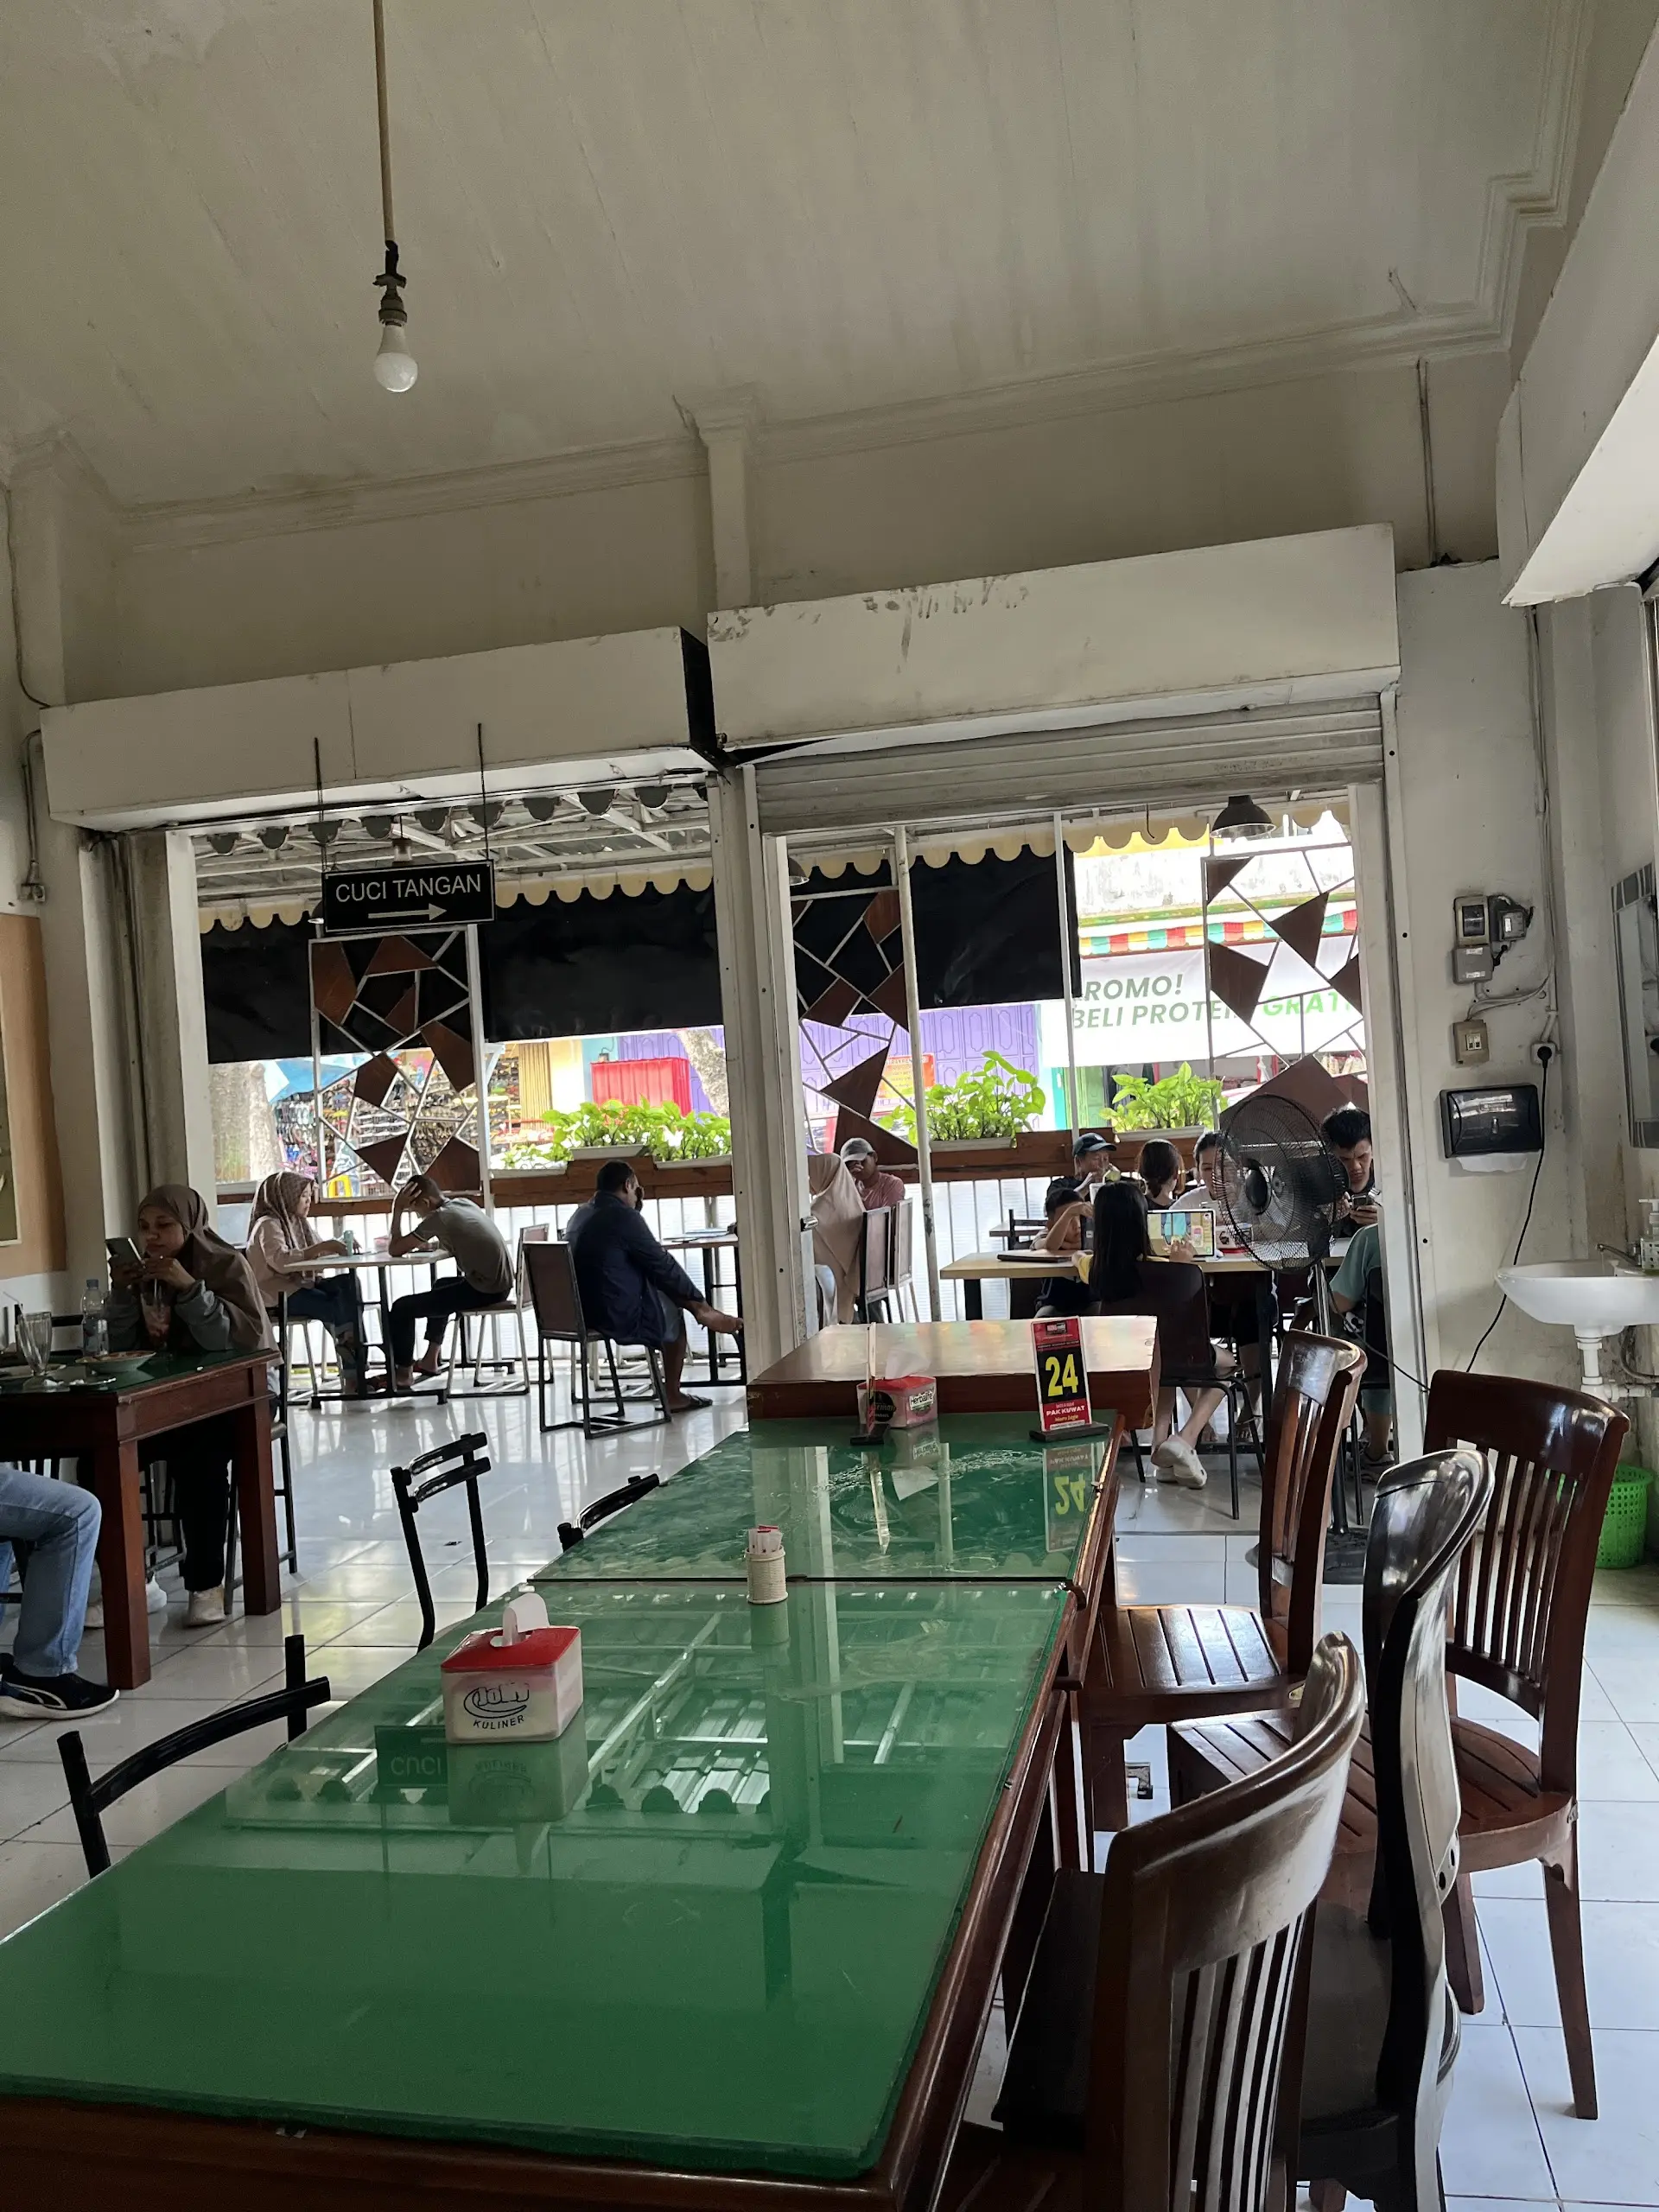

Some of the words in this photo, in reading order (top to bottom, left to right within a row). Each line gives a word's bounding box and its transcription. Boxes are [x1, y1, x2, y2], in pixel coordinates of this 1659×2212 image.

[335, 880, 387, 903] CUCI
[392, 874, 481, 899] TANGAN
[1084, 974, 1184, 1001] ROMO!
[1073, 1006, 1123, 1029] BELI
[1131, 1000, 1236, 1027] PROTEI
[1045, 1353, 1079, 1398] 24
[1061, 1405, 1086, 1414] KUWAT
[473, 1714, 525, 1730] KULINER
